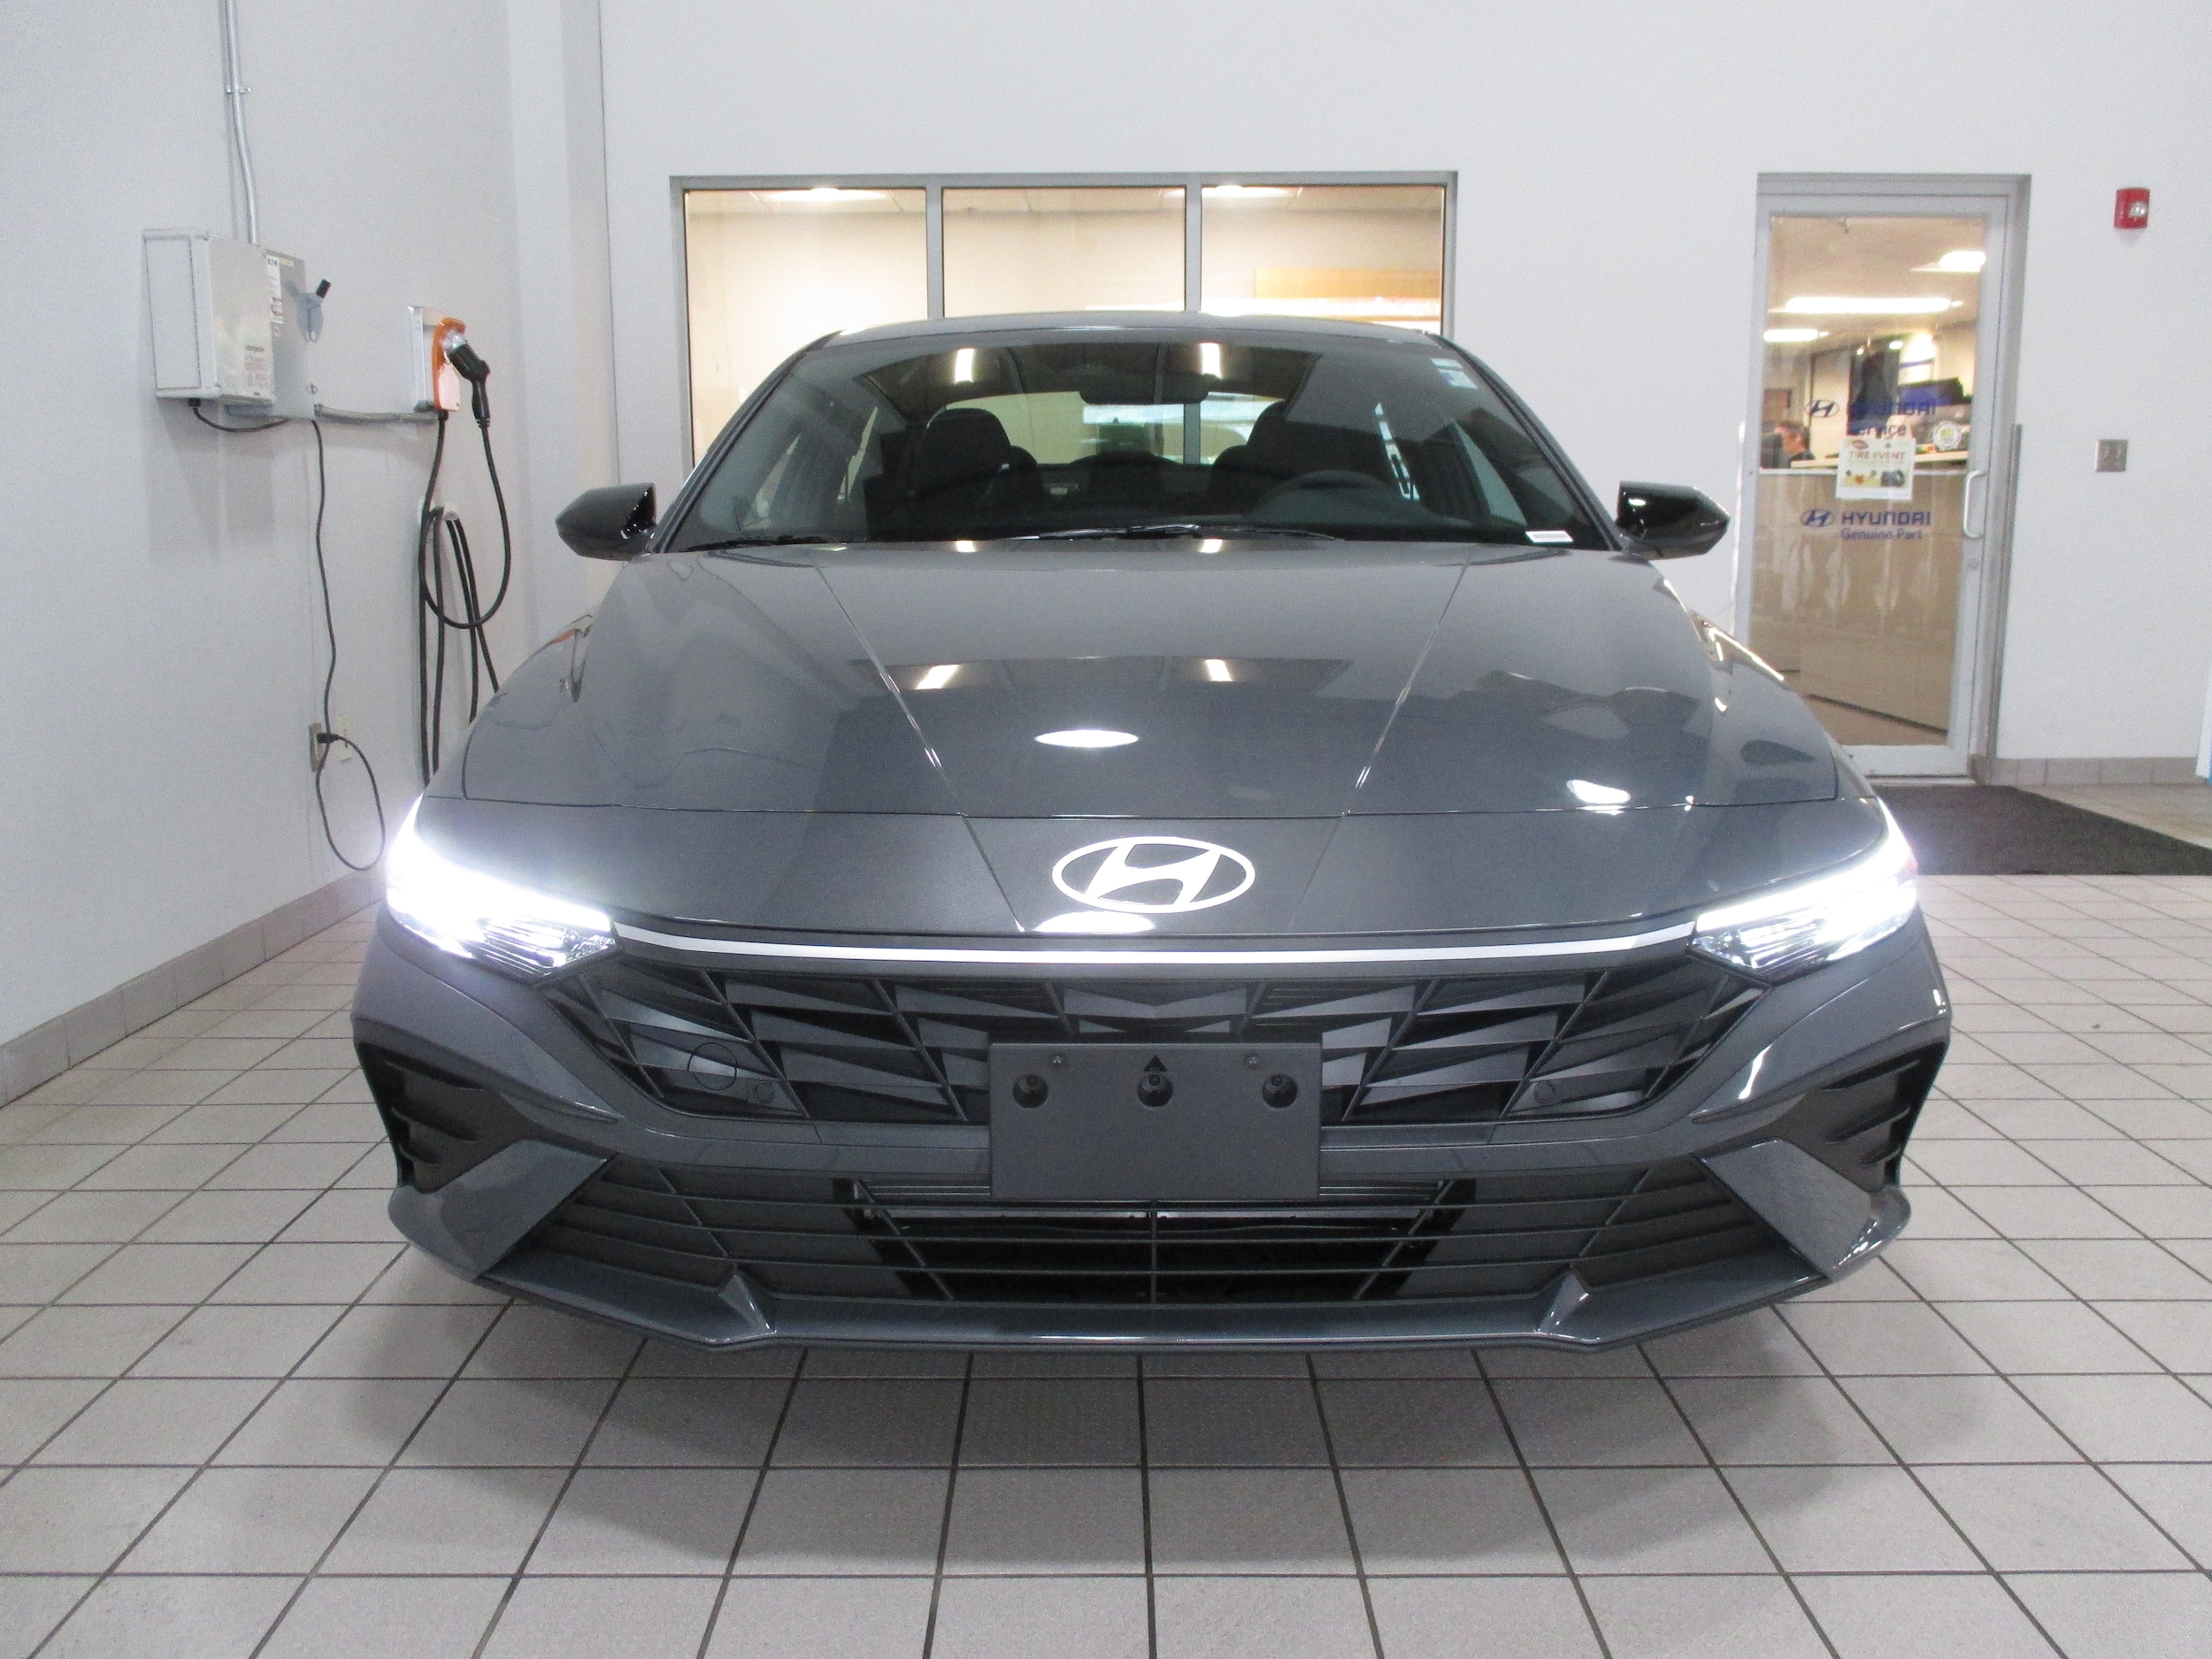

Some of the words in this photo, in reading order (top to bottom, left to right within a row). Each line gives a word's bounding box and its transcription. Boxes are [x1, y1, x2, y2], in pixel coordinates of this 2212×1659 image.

[1850, 421, 1906, 437] ervice
[1841, 511, 1931, 526] HYUNDAI
[1841, 527, 1893, 540] Genuine
[1896, 528, 1922, 540] Part
